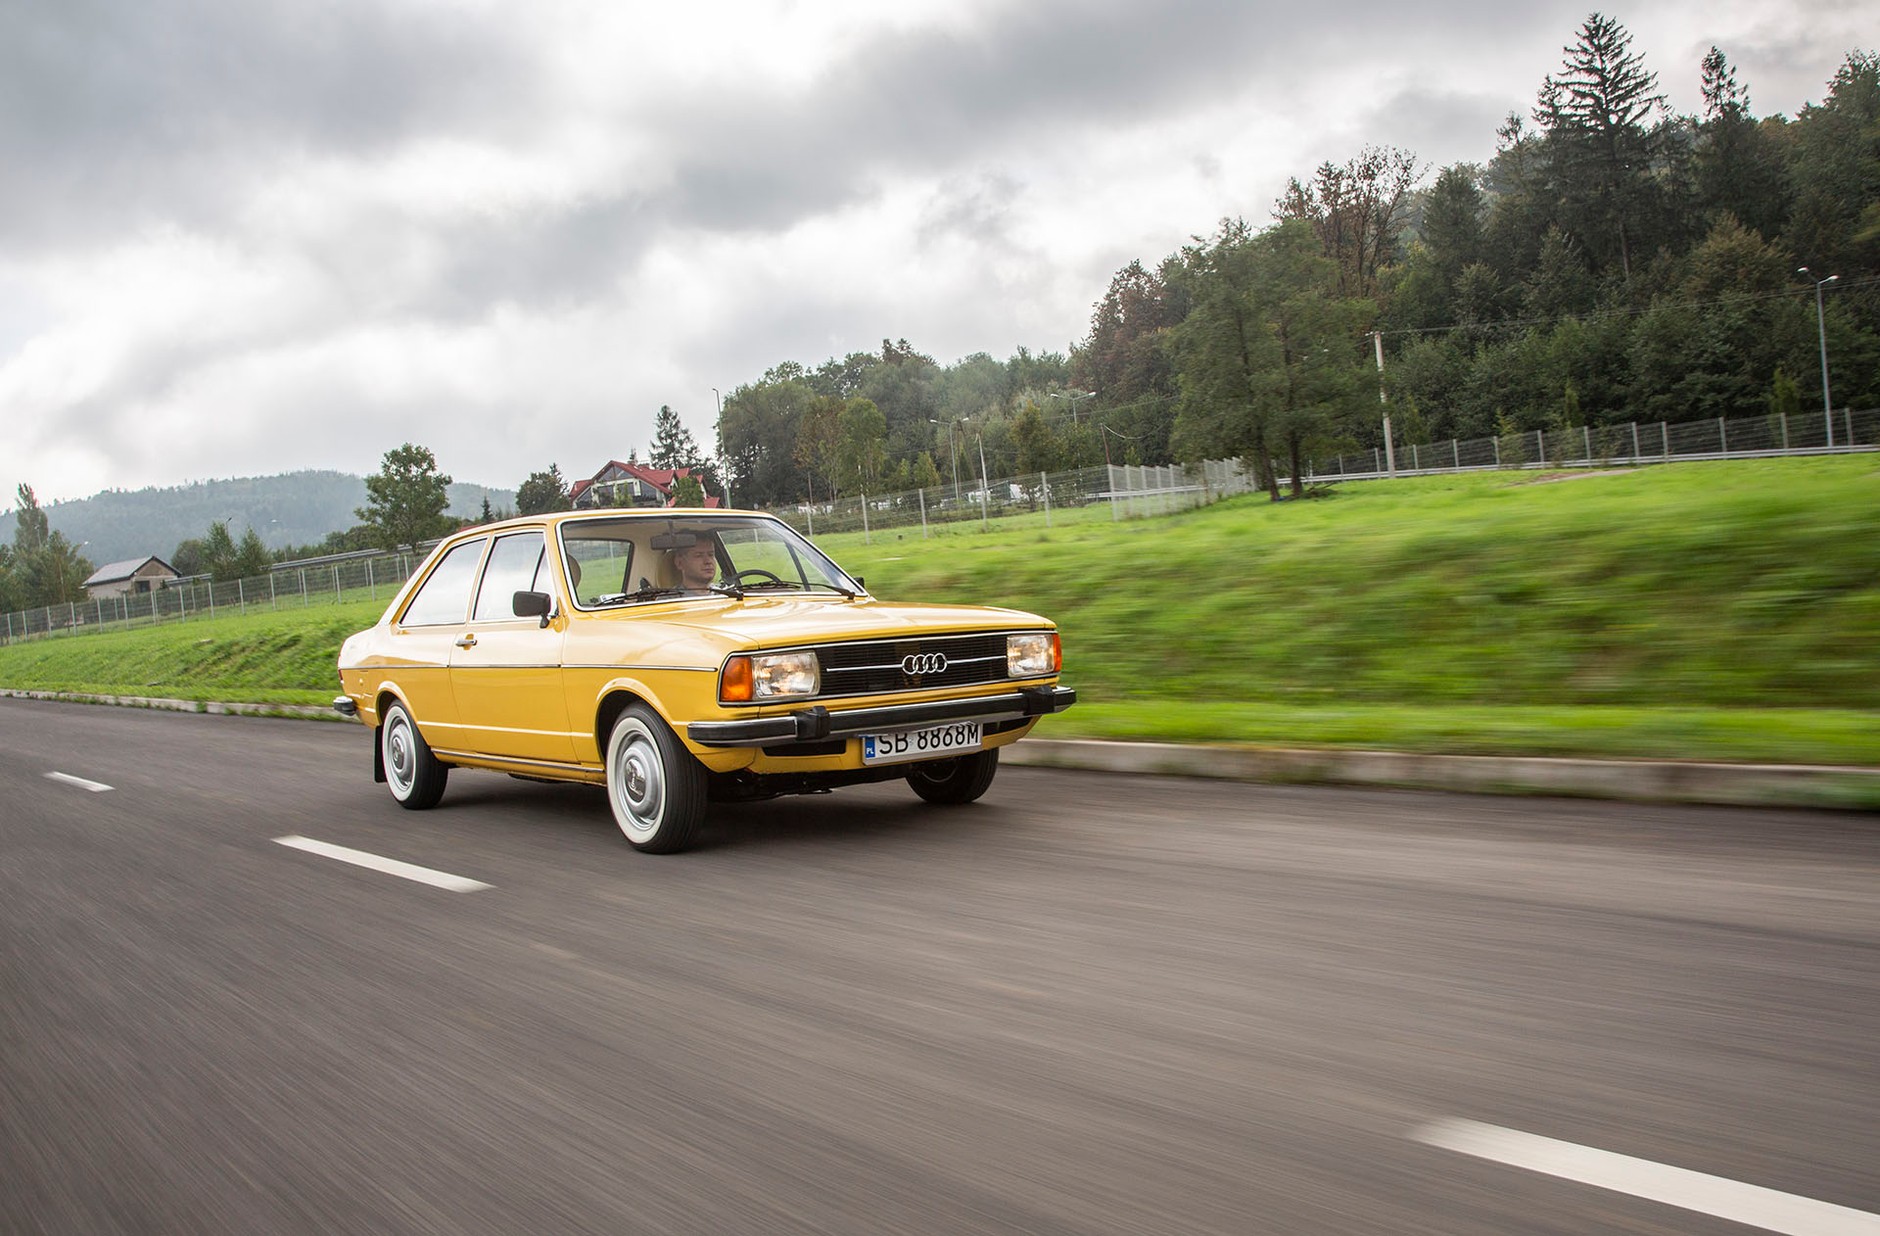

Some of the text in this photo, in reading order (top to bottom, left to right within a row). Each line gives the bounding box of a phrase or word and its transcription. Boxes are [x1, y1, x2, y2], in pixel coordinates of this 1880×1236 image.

[879, 723, 979, 755] SB 8868M
[866, 747, 874, 755] PL
